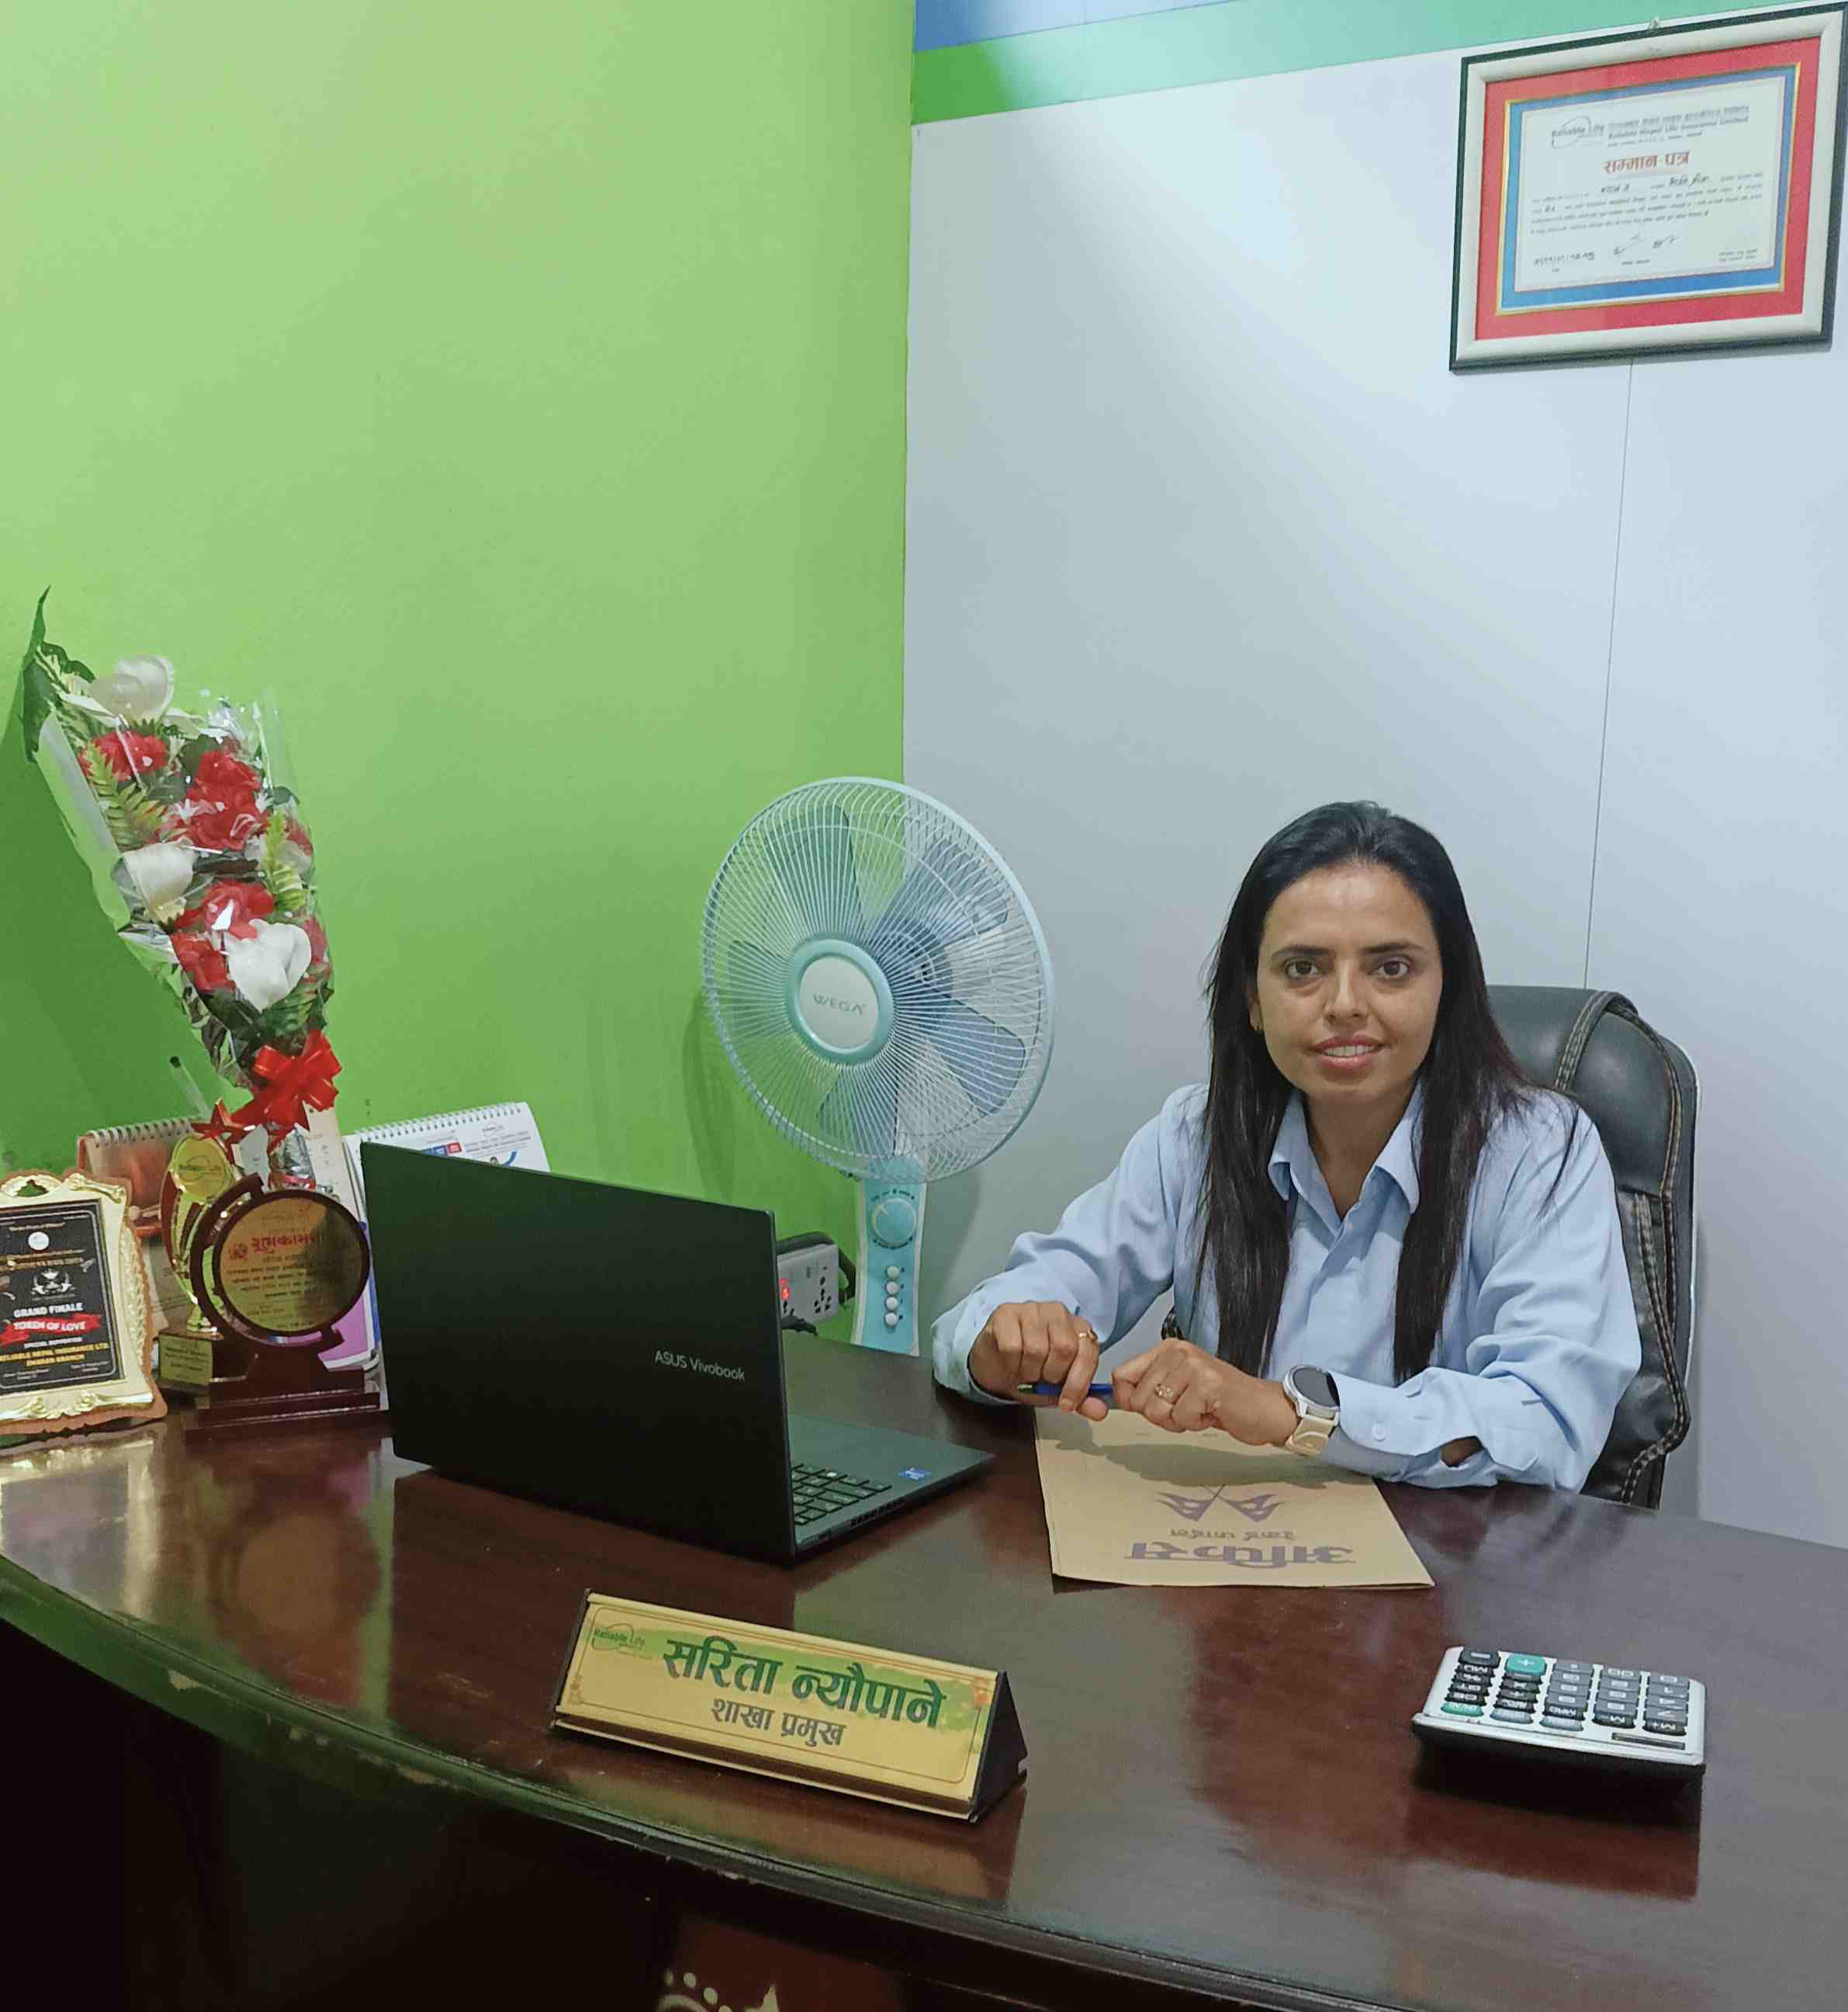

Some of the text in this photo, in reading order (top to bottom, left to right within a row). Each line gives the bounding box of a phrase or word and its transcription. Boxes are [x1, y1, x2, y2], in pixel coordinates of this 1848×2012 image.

[1604, 151, 1690, 174] सम्मान पत्र
[813, 993, 863, 1016] WEGA
[13, 1302, 83, 1318] GRAND FINALE
[13, 1321, 86, 1331] TOKEN OF LOVE
[655, 1349, 746, 1381] ASUS Vivobook
[594, 1626, 628, 1645] Reliable
[663, 1636, 947, 1727] सरिता न्यौपाने
[711, 1698, 847, 1747] शाखा प्रमुख
